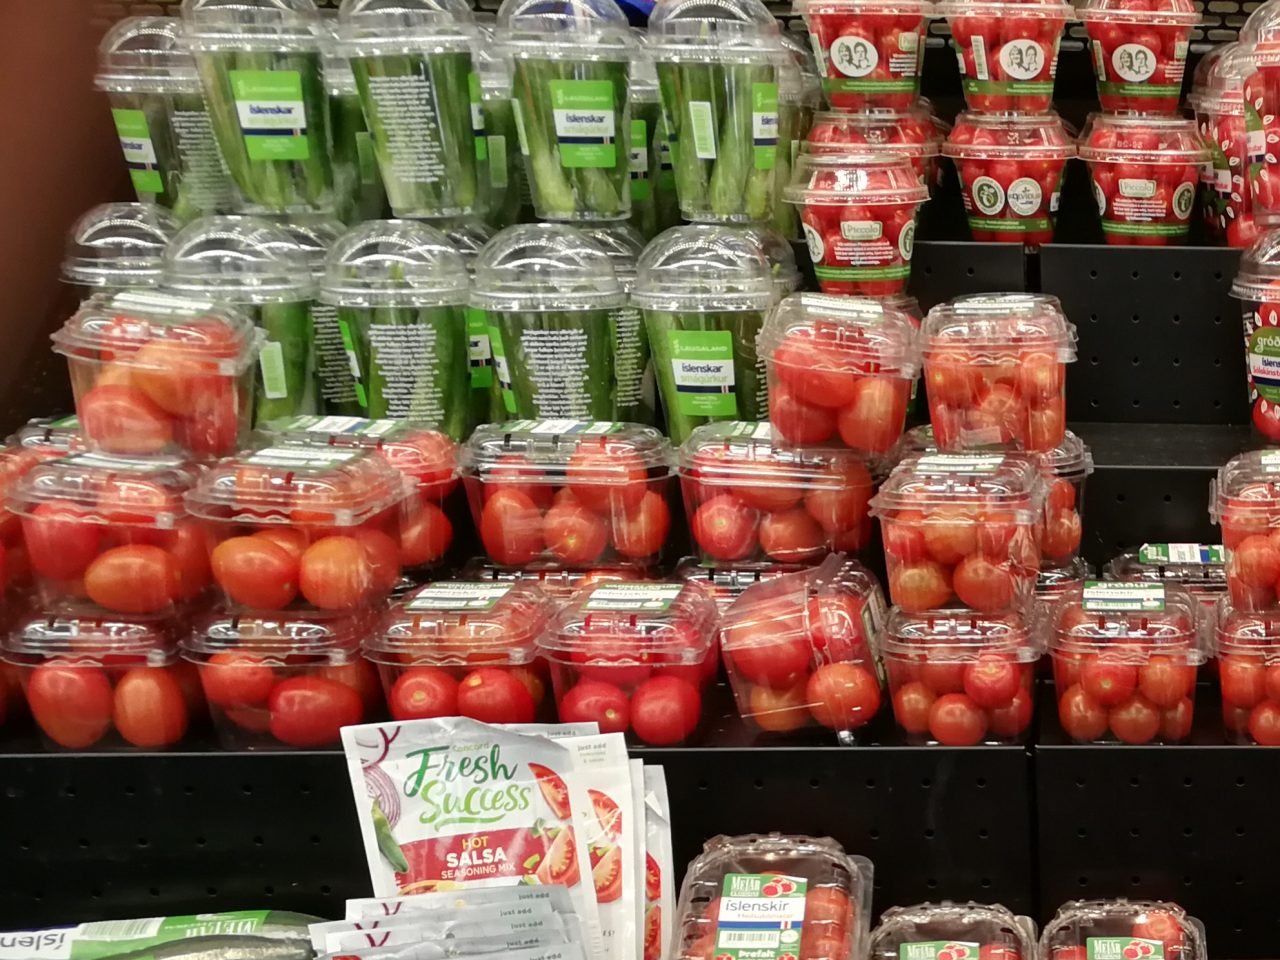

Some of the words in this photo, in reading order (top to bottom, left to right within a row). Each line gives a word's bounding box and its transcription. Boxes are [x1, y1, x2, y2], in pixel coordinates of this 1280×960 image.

[566, 113, 605, 123] íslenskar
[682, 363, 723, 373] íslenskar
[404, 744, 517, 797] Fresh
[419, 780, 531, 831] Success
[463, 836, 488, 849] HOT
[447, 848, 507, 867] SALSA
[441, 866, 496, 880] SEASONING
[498, 864, 515, 873] MIX
[725, 900, 789, 912] íslenskir
[739, 950, 775, 958] Þrefalt
